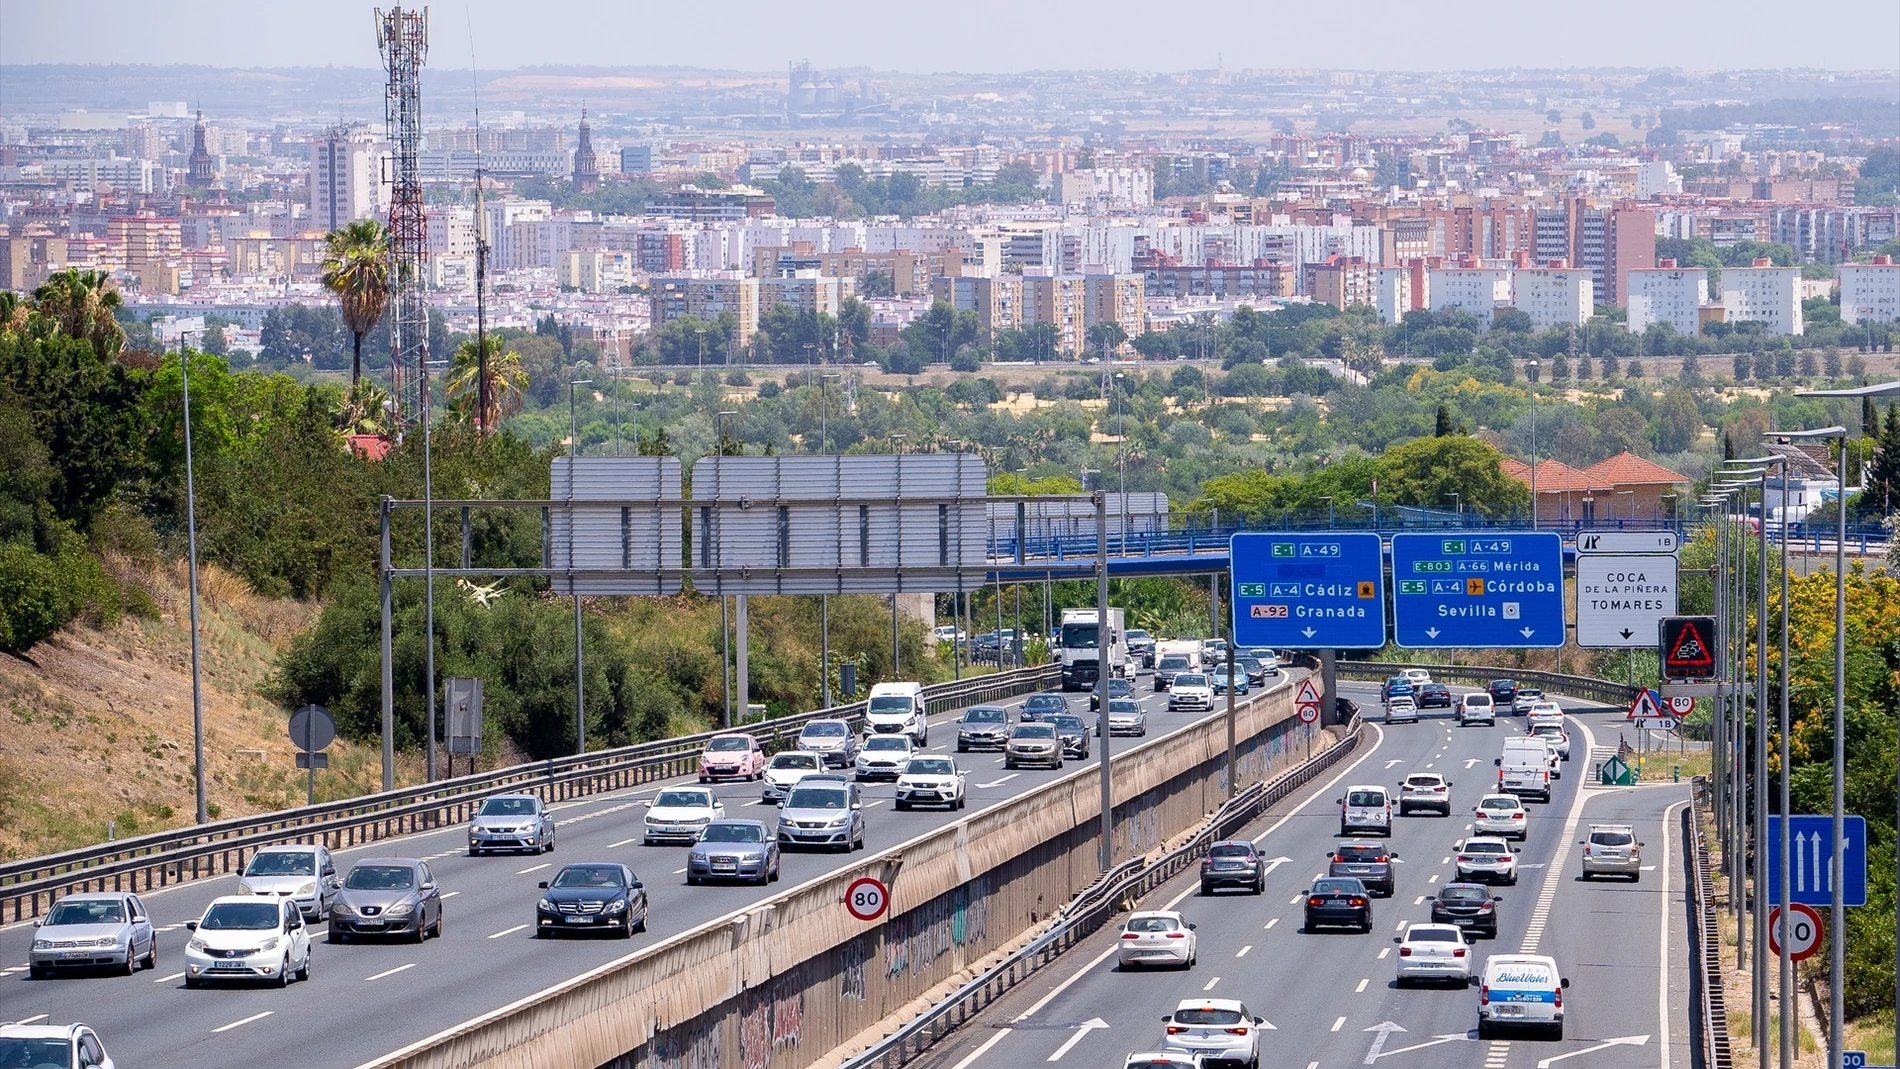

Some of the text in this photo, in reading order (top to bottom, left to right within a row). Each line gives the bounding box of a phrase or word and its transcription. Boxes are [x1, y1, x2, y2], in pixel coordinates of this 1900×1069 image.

[1274, 545, 1339, 555] E-1 A-49
[1444, 542, 1510, 552] E-1 A-49
[1414, 560, 1540, 571] E-803 A-66 Mérida
[1607, 573, 1647, 583] COCA
[1240, 584, 1352, 596] E-5 A-4 Cádiz
[1401, 580, 1555, 593] E-5 A-4 Córdoba
[1624, 584, 1668, 594] PIÑERA
[1591, 600, 1663, 610] TOMARES
[1252, 605, 1365, 618] A-92 Granada
[1438, 604, 1496, 617] Sevilla
[1674, 698, 1690, 707] 80
[1303, 710, 1314, 718] 80
[854, 891, 879, 907] 80
[1496, 973, 1548, 983] BlueWater
